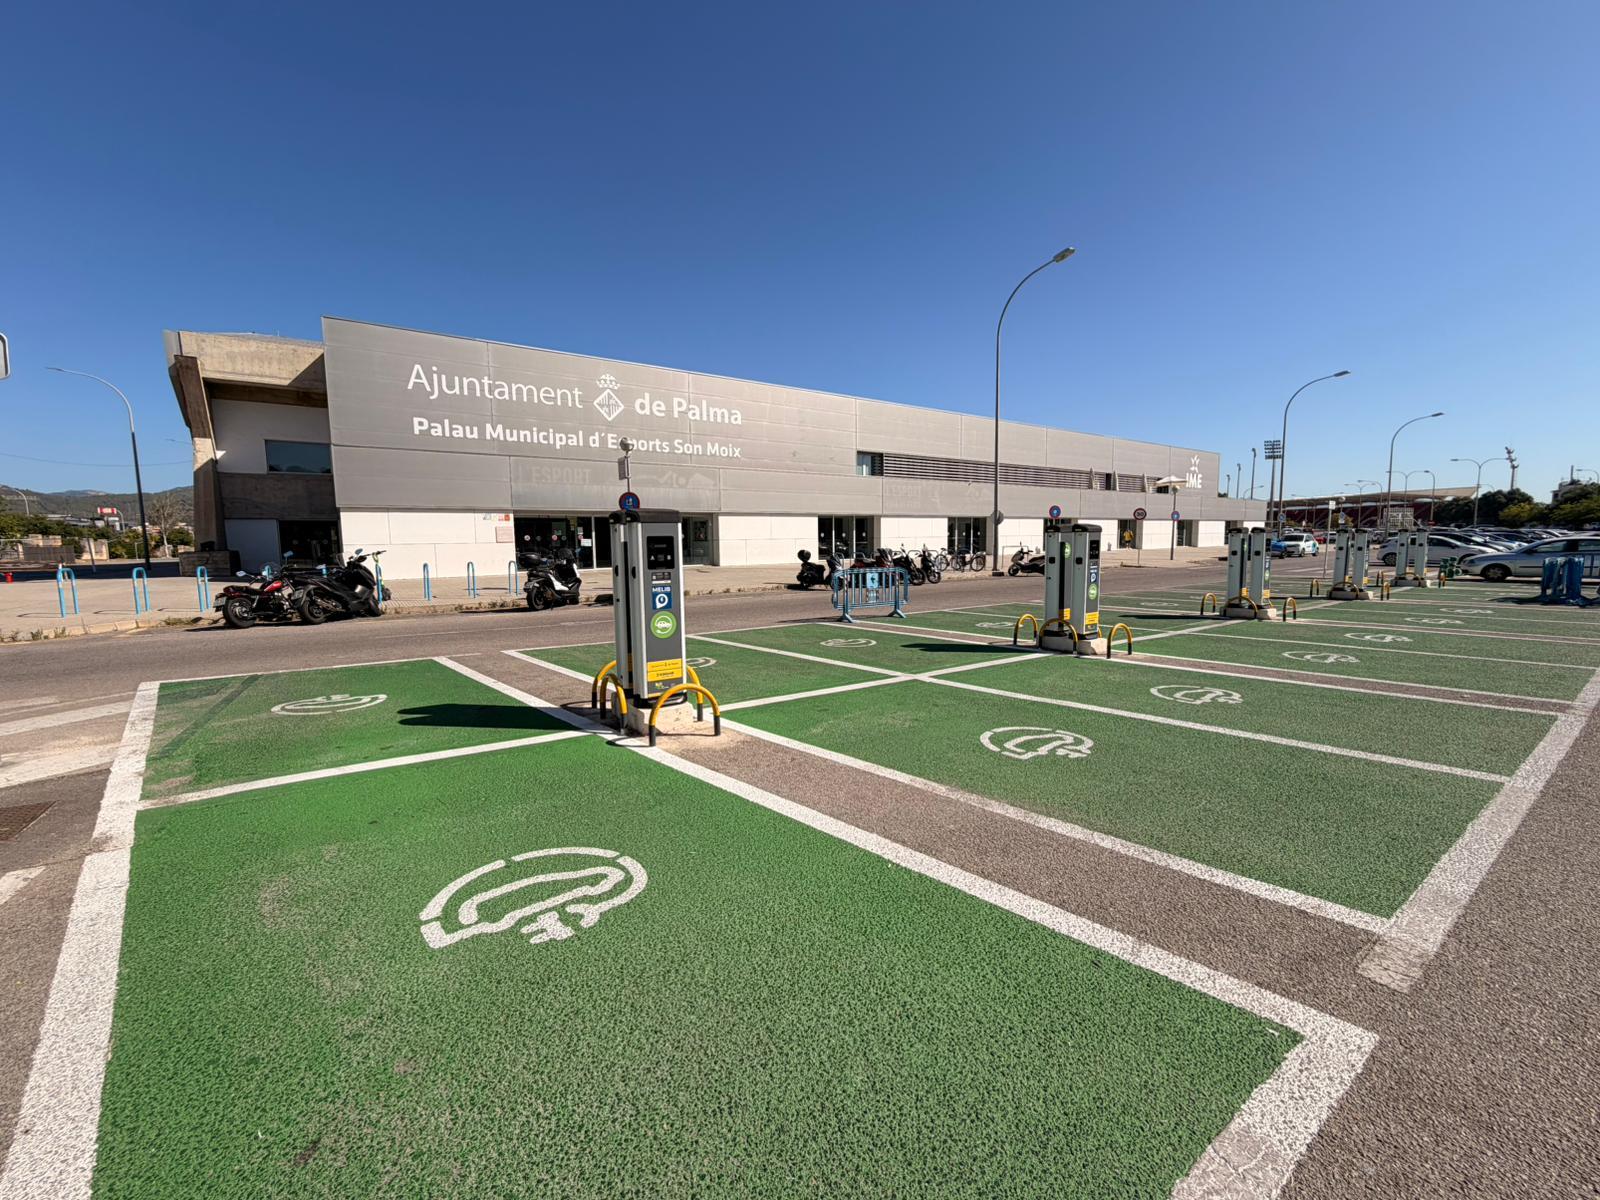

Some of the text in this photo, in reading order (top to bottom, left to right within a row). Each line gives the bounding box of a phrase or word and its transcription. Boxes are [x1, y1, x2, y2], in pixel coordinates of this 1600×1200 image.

[407, 364, 742, 425] Ajuntament de Palma
[412, 416, 478, 439] Palau
[485, 423, 583, 449] Municipal
[674, 439, 702, 455] Son
[707, 441, 741, 458] Moix
[1186, 472, 1202, 488] IME
